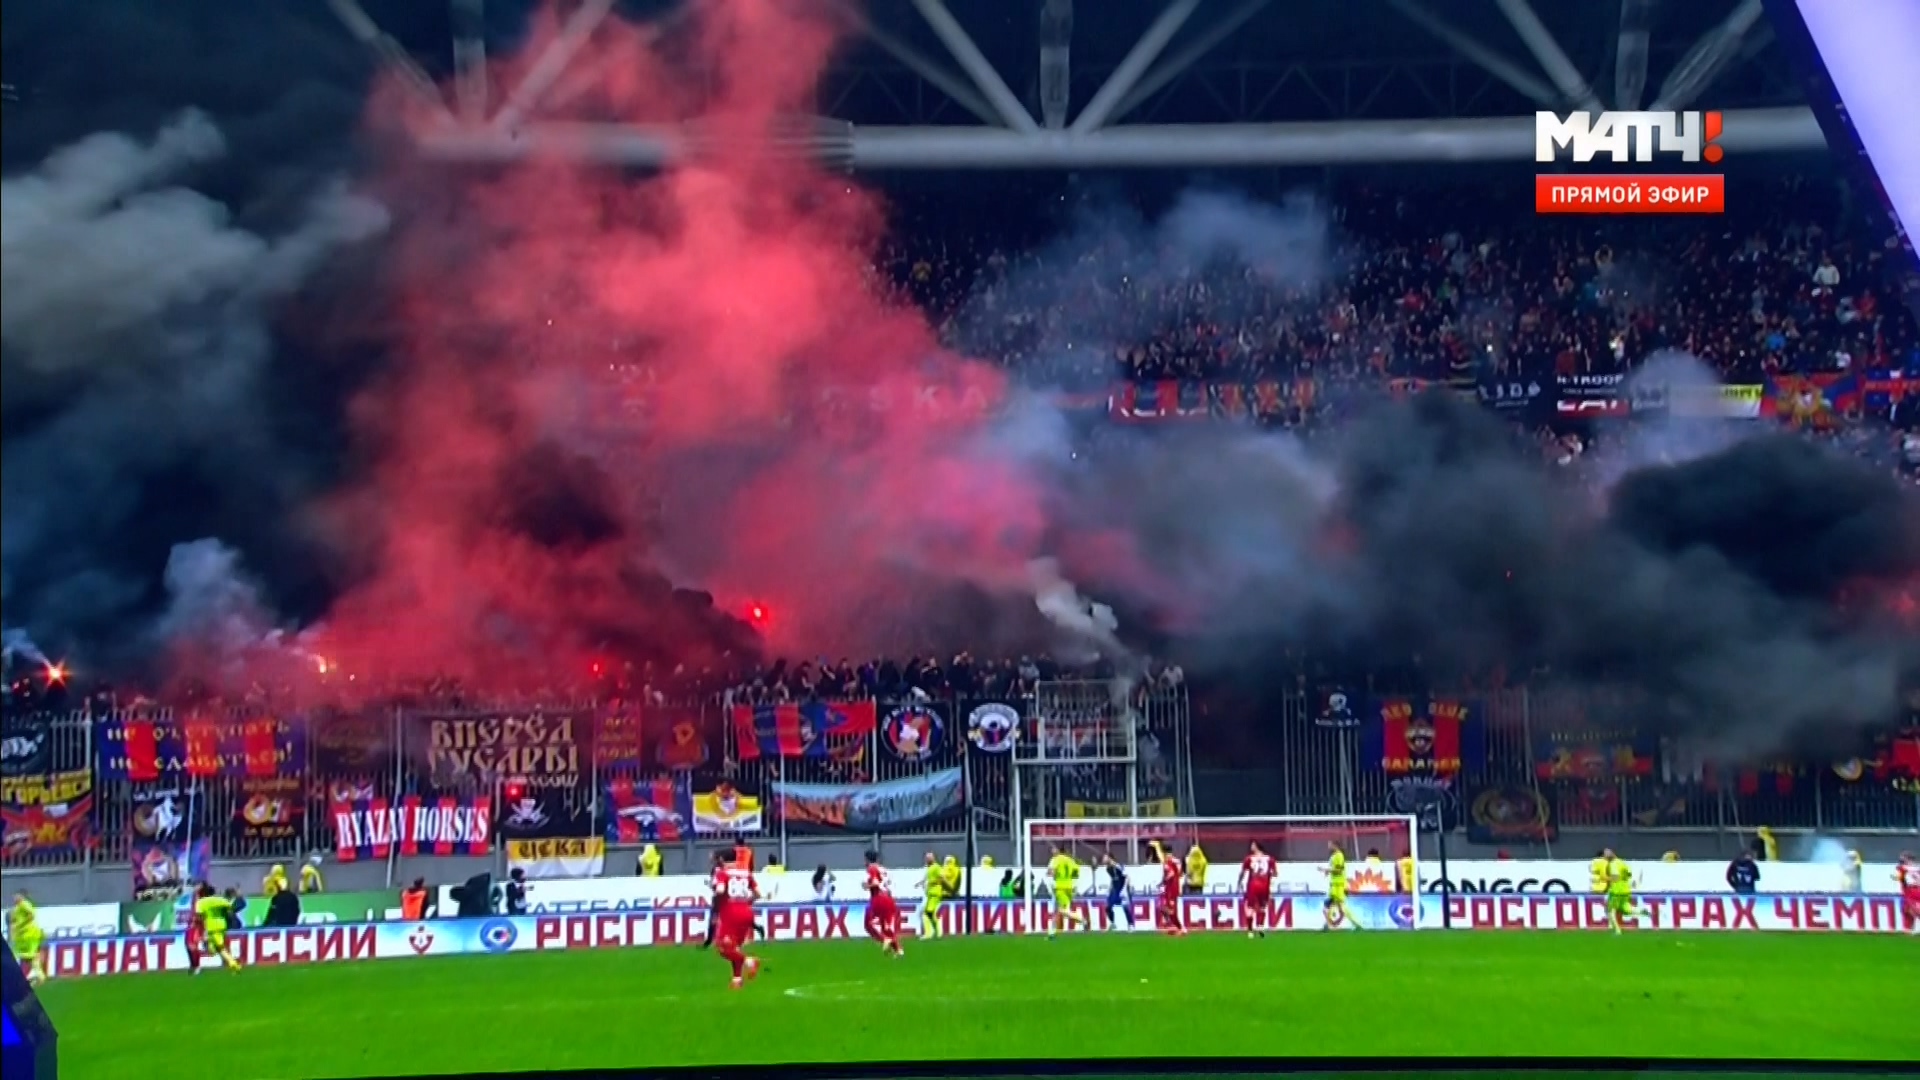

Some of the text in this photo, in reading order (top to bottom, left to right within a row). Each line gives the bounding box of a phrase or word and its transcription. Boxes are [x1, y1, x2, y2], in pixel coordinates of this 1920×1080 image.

[336, 803, 491, 848] RYAZAN HORSES
[201, 925, 377, 967] ОССИИ
[536, 906, 849, 950] РОСГОСРАХ
